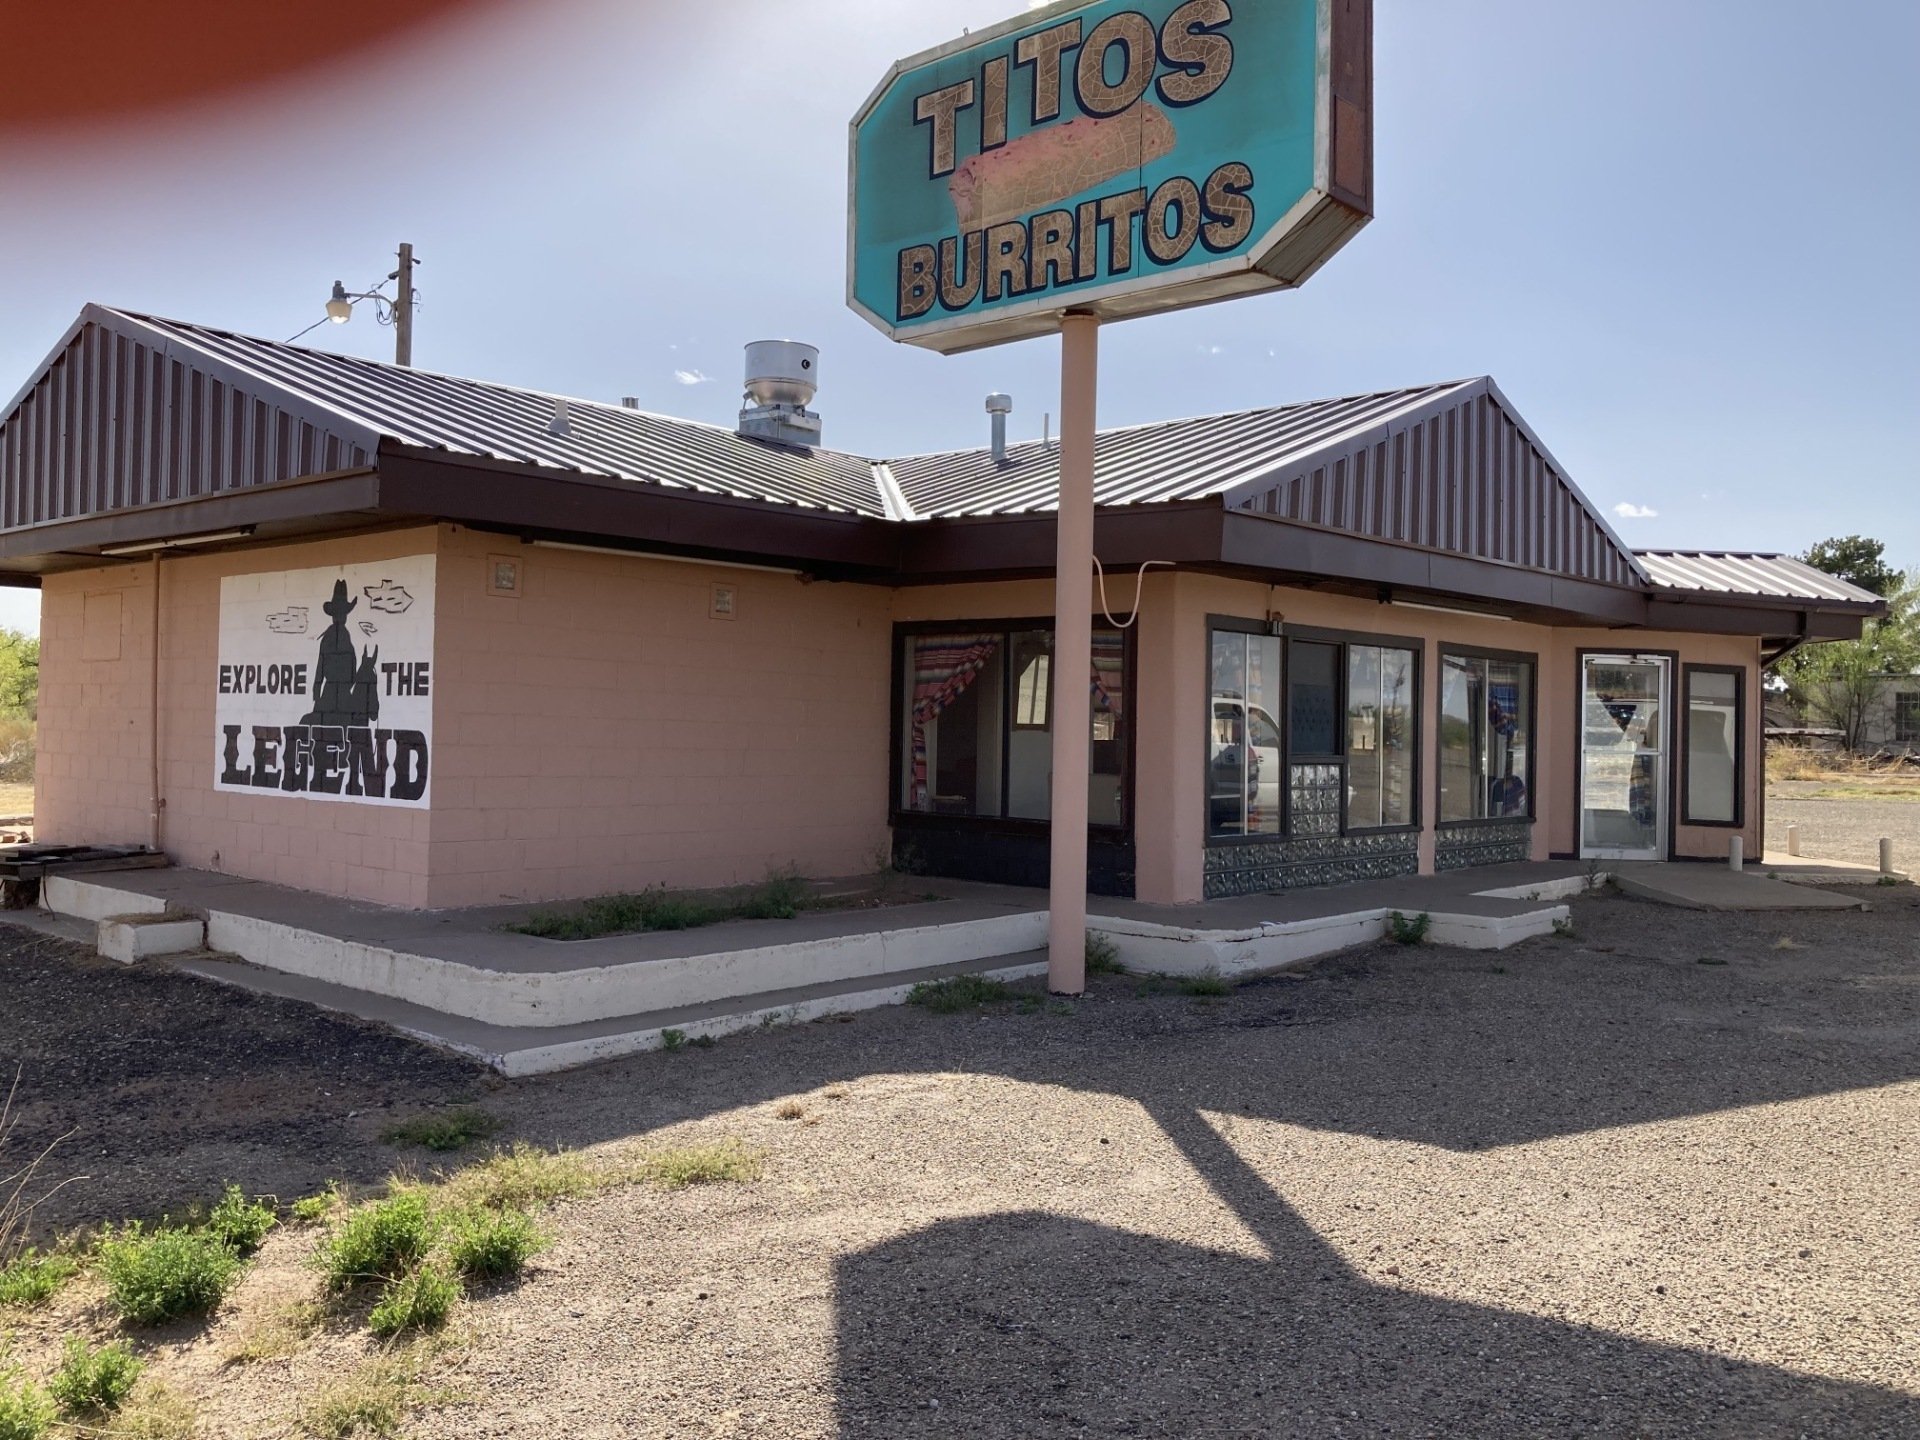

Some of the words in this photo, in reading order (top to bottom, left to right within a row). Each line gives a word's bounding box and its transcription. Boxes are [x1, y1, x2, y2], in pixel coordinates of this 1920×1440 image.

[914, 0, 1234, 180] TITOS
[896, 161, 1254, 322] BURRITOS
[219, 663, 307, 695] EXPLORE
[381, 662, 430, 696] THE
[220, 724, 429, 801] LEGEND
